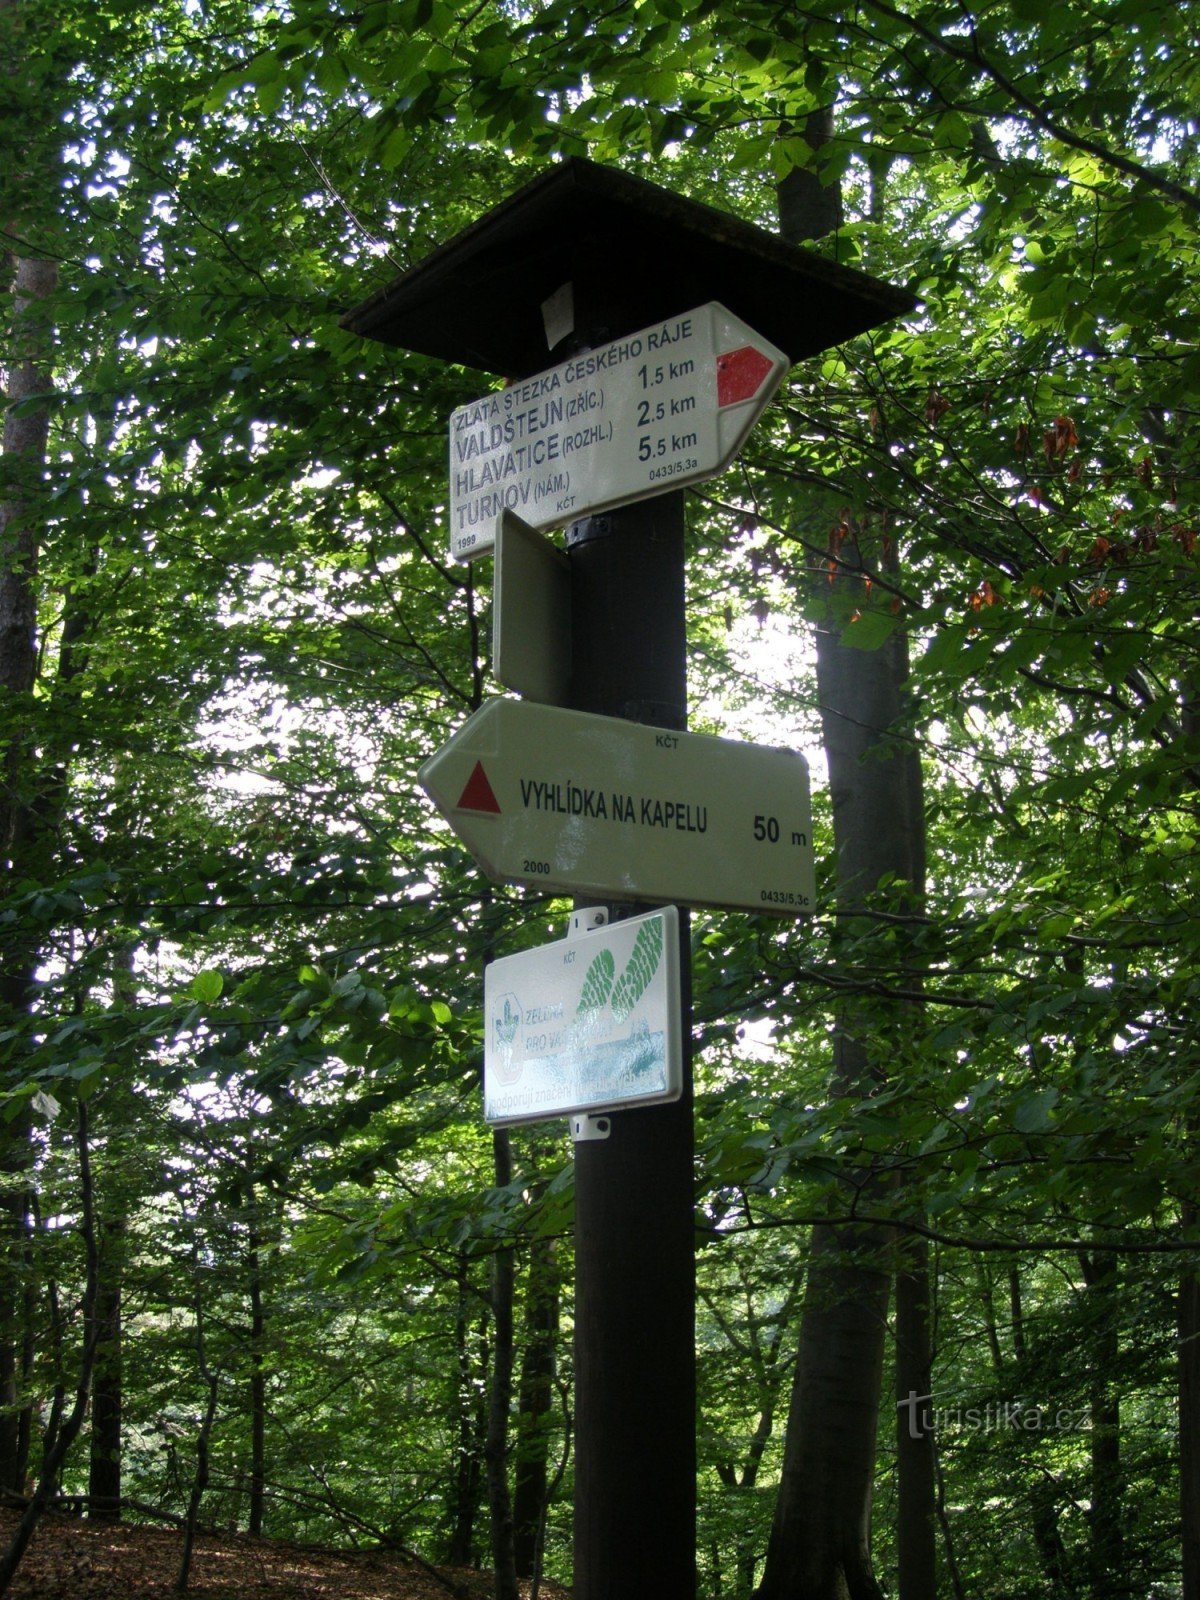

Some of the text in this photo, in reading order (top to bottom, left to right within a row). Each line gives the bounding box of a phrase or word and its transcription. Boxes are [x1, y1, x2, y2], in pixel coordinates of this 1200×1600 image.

[456, 319, 693, 432] ZLATÁ STEZKA ČESKÉHO RÁJE
[456, 359, 694, 463] VALDŠTEJN (ZŘÍC.) 1.5 km
[456, 396, 696, 497] HLAVATICE (ROZHL.) 2.5 km
[649, 458, 698, 481] 0433/5,3a
[456, 432, 697, 530] TURNOV (NÁM.) 5.5 km
[556, 496, 576, 512] KČT
[457, 534, 477, 550] 1999
[655, 735, 679, 750] KČT
[520, 779, 807, 847] VYHLÍDKA NA KAPELU 50 m
[523, 860, 550, 875] 2000
[760, 890, 810, 907] 0433/5,3c
[563, 950, 577, 965] KČT
